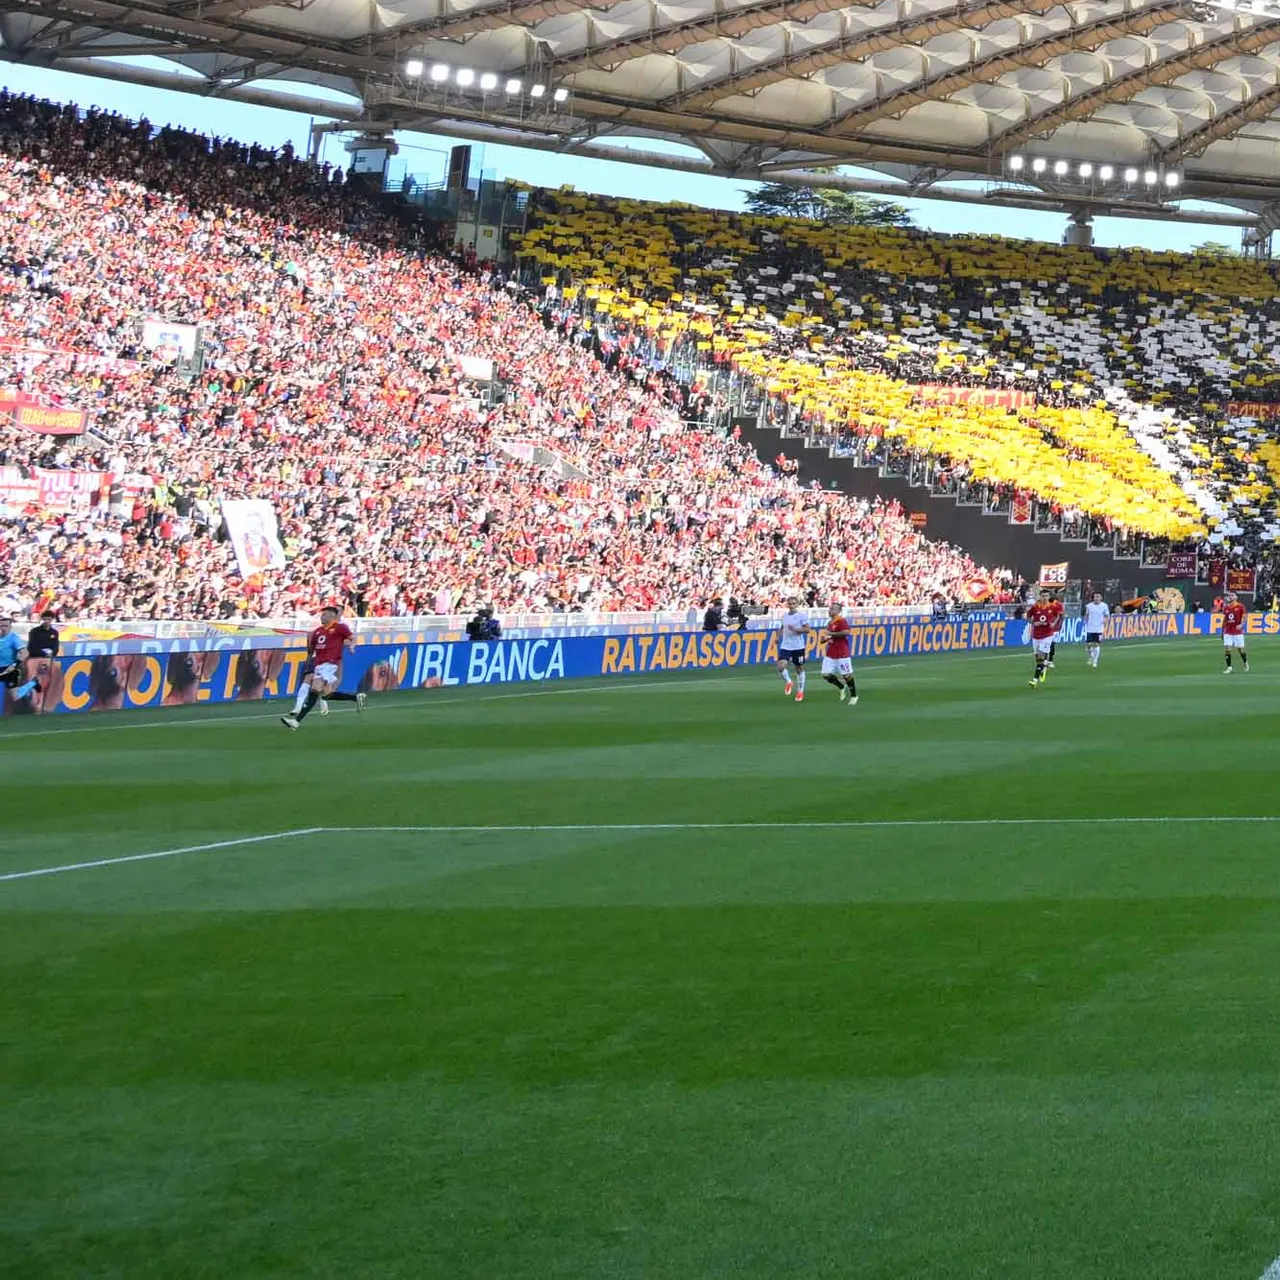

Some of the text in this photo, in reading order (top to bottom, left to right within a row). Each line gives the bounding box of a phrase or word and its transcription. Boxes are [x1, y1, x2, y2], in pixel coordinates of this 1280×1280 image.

[601, 628, 778, 673] RATABASSOTTA
[890, 625, 906, 651] IN
[911, 623, 968, 651] PICCOLE
[971, 621, 1006, 648] RATE
[1103, 613, 1178, 640] RATABASSOTTA
[1184, 613, 1202, 635] IL
[412, 639, 565, 688] IBL BANCA
